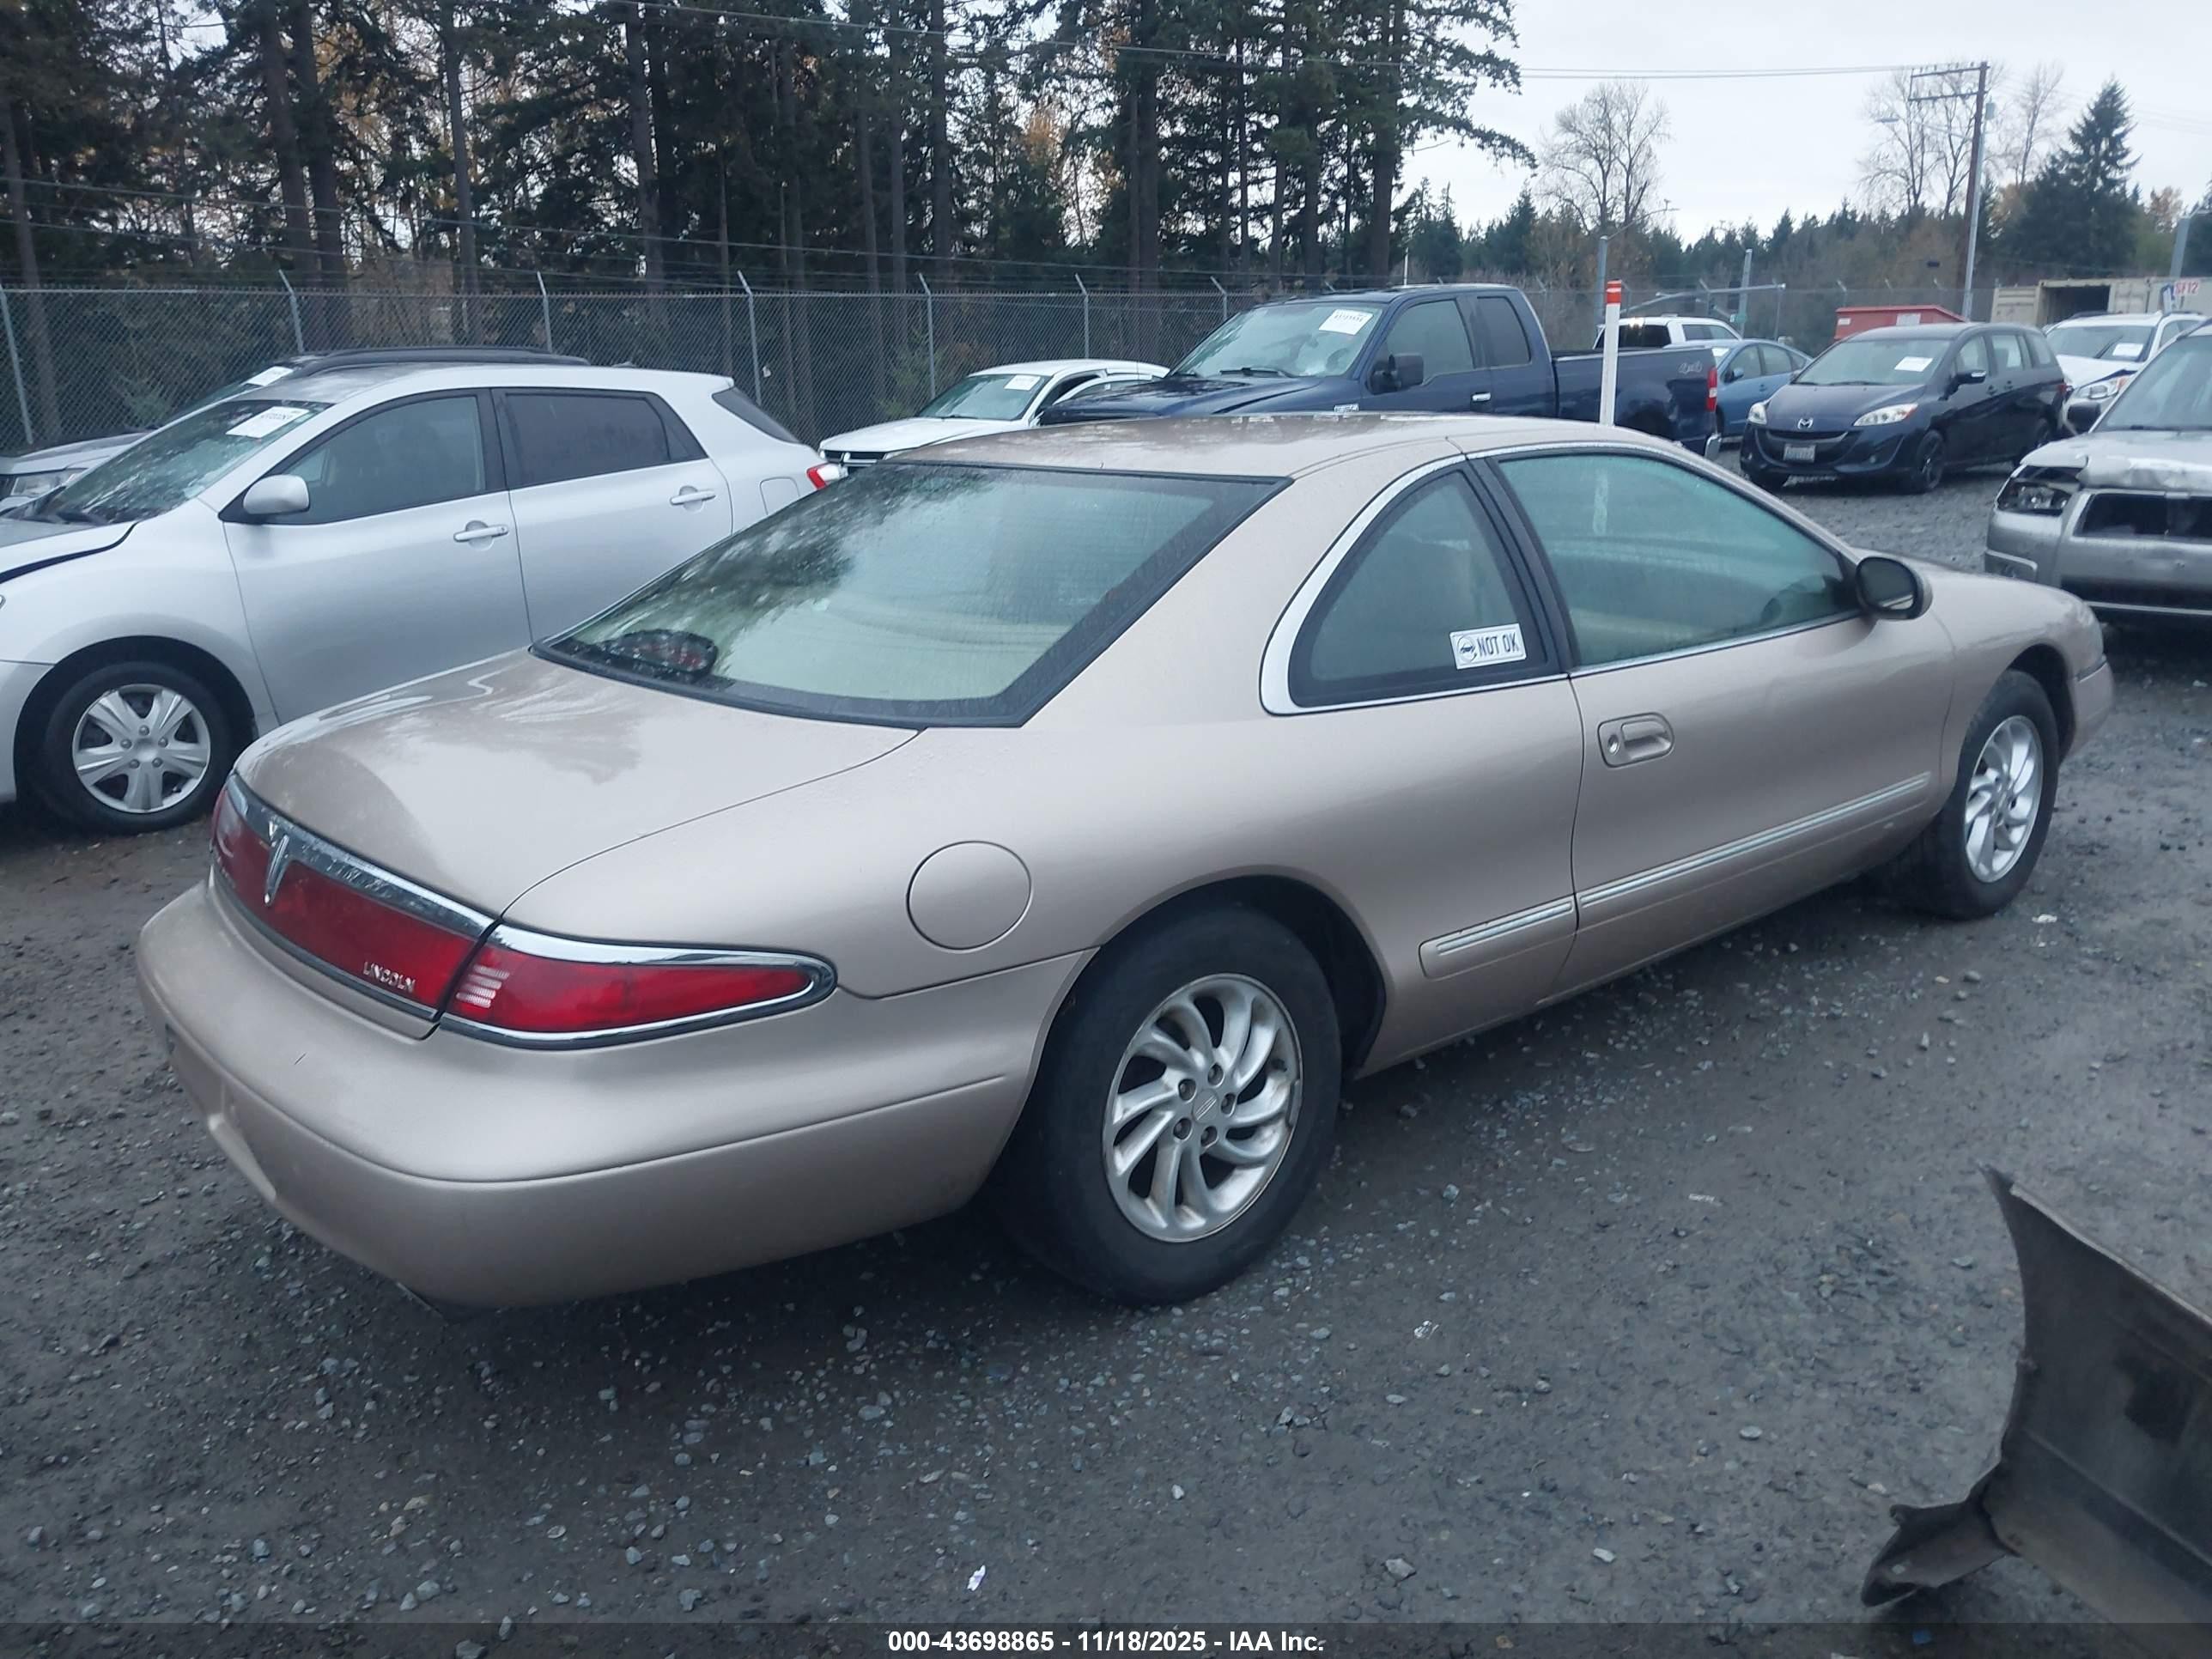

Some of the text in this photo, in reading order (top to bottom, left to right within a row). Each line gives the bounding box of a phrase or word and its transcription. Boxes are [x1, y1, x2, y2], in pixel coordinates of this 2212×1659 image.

[1477, 631, 1519, 657] NOT OK
[362, 961, 416, 993] LINCOLN
